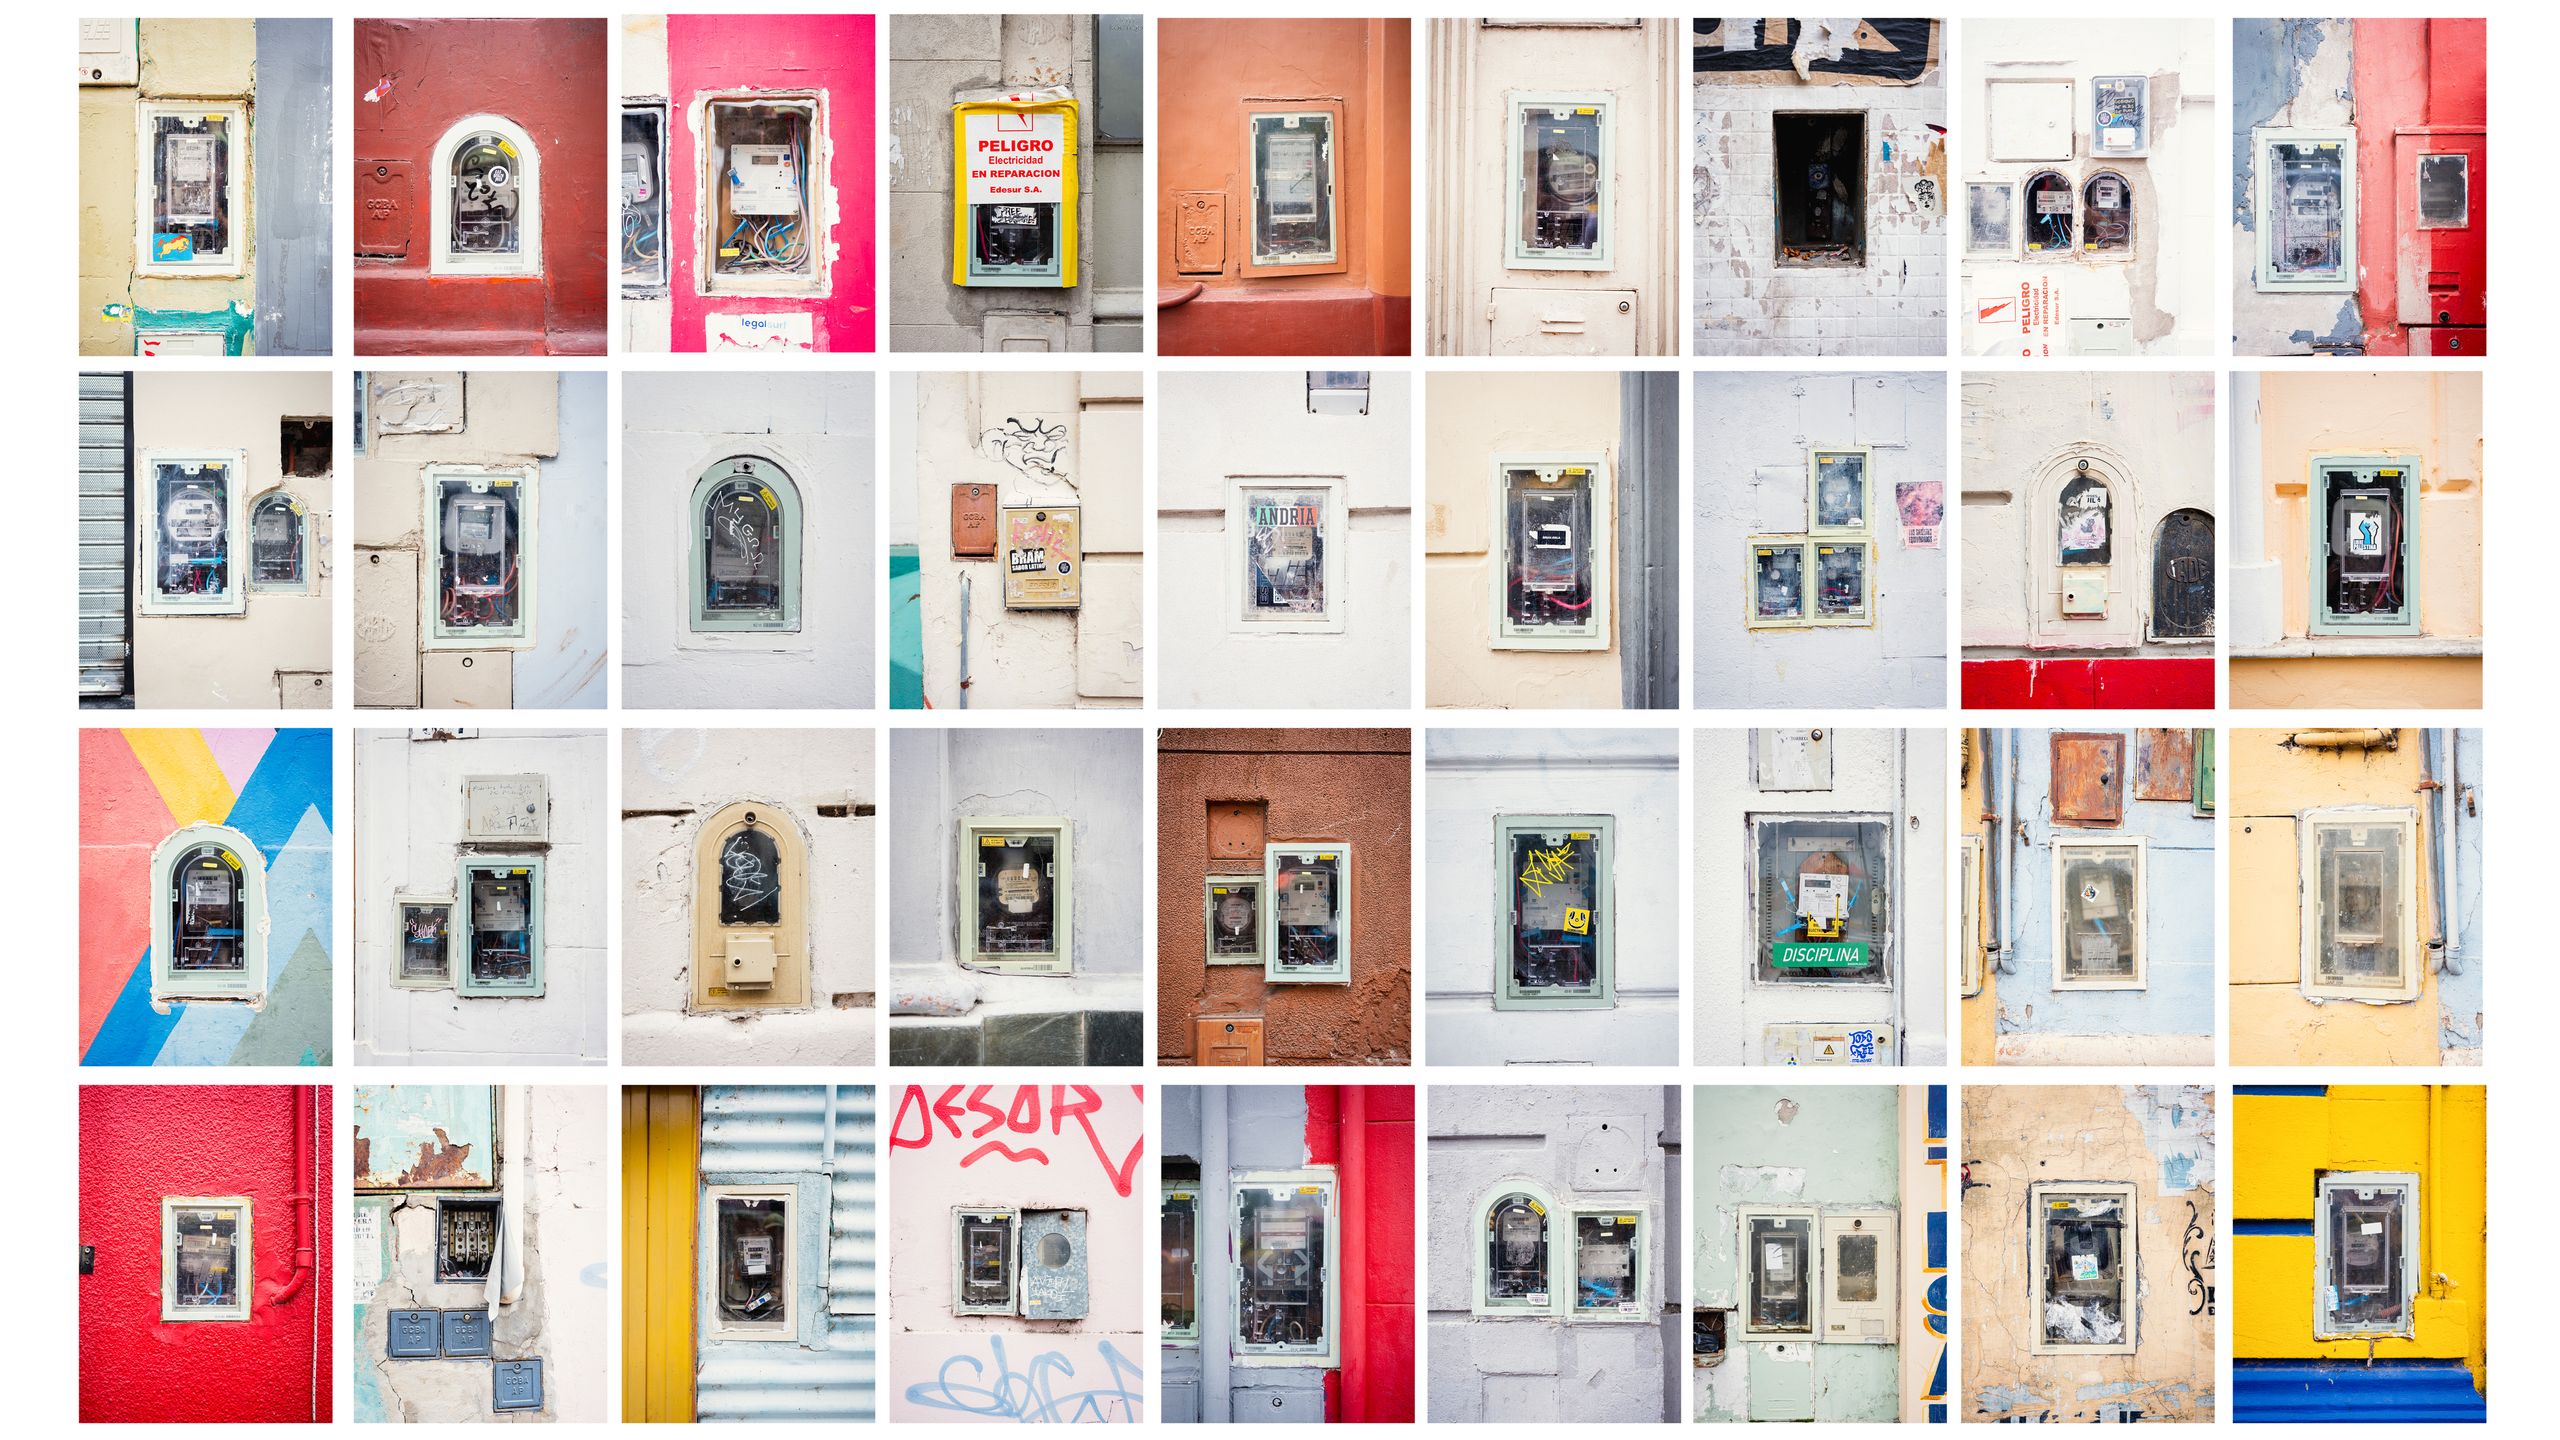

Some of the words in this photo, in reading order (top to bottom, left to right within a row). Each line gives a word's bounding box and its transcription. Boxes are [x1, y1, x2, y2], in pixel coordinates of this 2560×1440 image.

[979, 139, 1054, 152] PELIGRO
[988, 156, 1043, 165] Electricidad
[972, 170, 987, 178] EN
[990, 170, 1060, 178] REPARACION
[2021, 282, 2031, 334] PELIGRO
[2042, 326, 2049, 337] EN
[1258, 507, 1316, 526] ANDRIA
[1011, 550, 1045, 565] BRAM
[1012, 564, 1028, 572] SABOR
[1028, 563, 1046, 571] LATINO
[1782, 947, 1859, 962] DISCIPLINA
[1848, 1029, 1873, 1044] TODO
